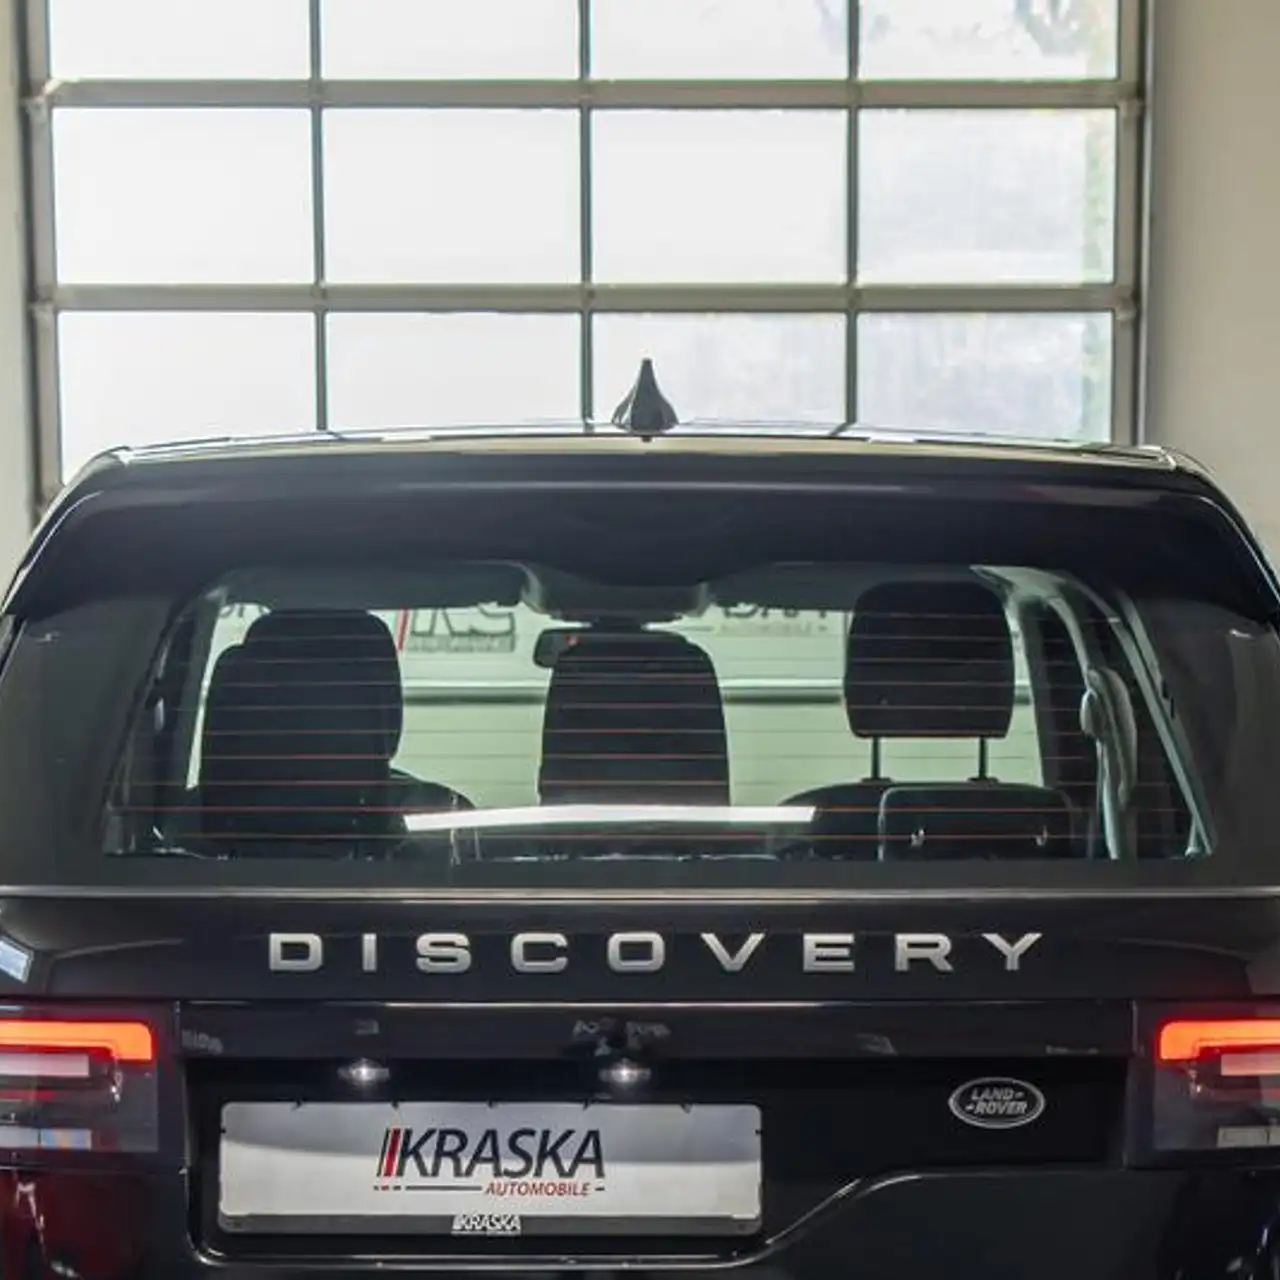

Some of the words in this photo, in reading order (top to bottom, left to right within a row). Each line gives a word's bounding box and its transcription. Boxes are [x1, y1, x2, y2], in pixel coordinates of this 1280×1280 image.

[268, 931, 1043, 973] DISCOVERY
[971, 1087, 1015, 1100] LAND
[974, 1101, 1027, 1115] ROVER
[396, 1128, 605, 1178] KRASKA
[485, 1181, 590, 1197] AUTOMOBILE
[456, 1214, 521, 1231] KRASKA
